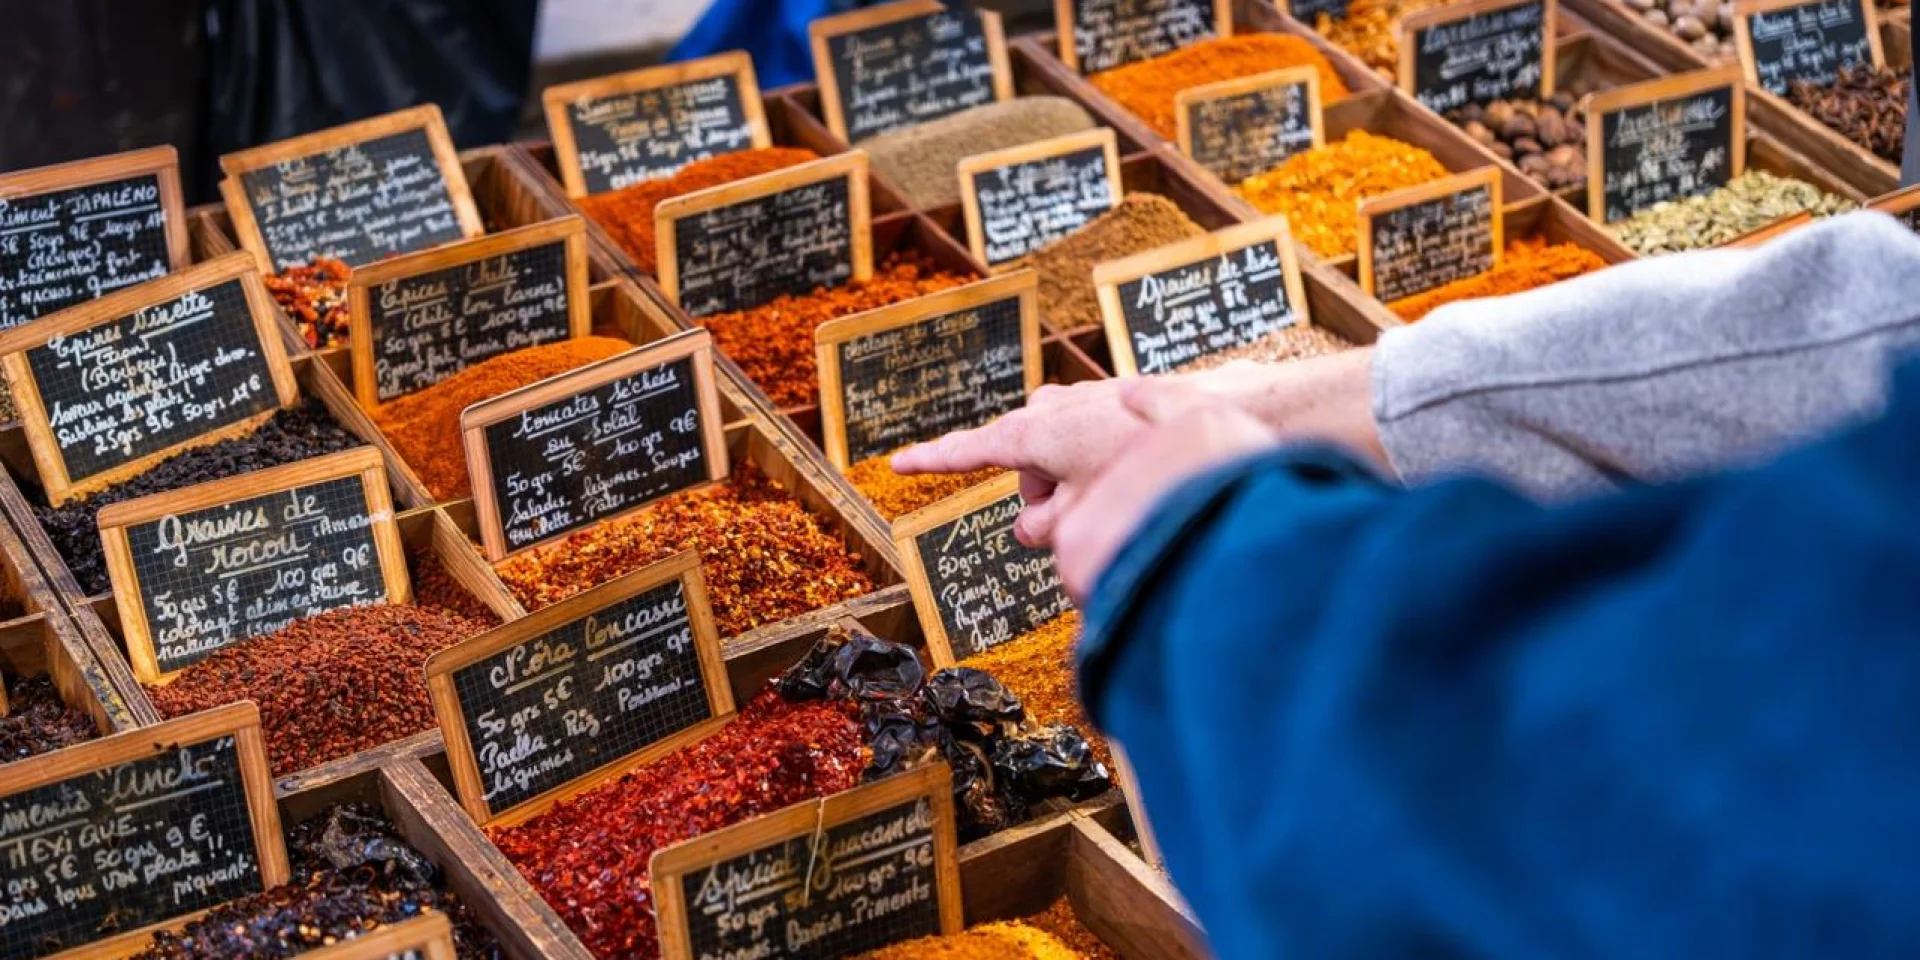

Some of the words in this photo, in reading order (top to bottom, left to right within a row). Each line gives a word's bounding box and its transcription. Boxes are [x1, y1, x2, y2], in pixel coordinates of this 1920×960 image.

[562, 450, 587, 477] 5€
[669, 408, 699, 434] 9€
[154, 504, 270, 567] Graines
[282, 488, 326, 521] de
[211, 579, 240, 604] 5€
[343, 543, 371, 573] 9€
[543, 675, 574, 710] 5€
[666, 628, 692, 654] 9€
